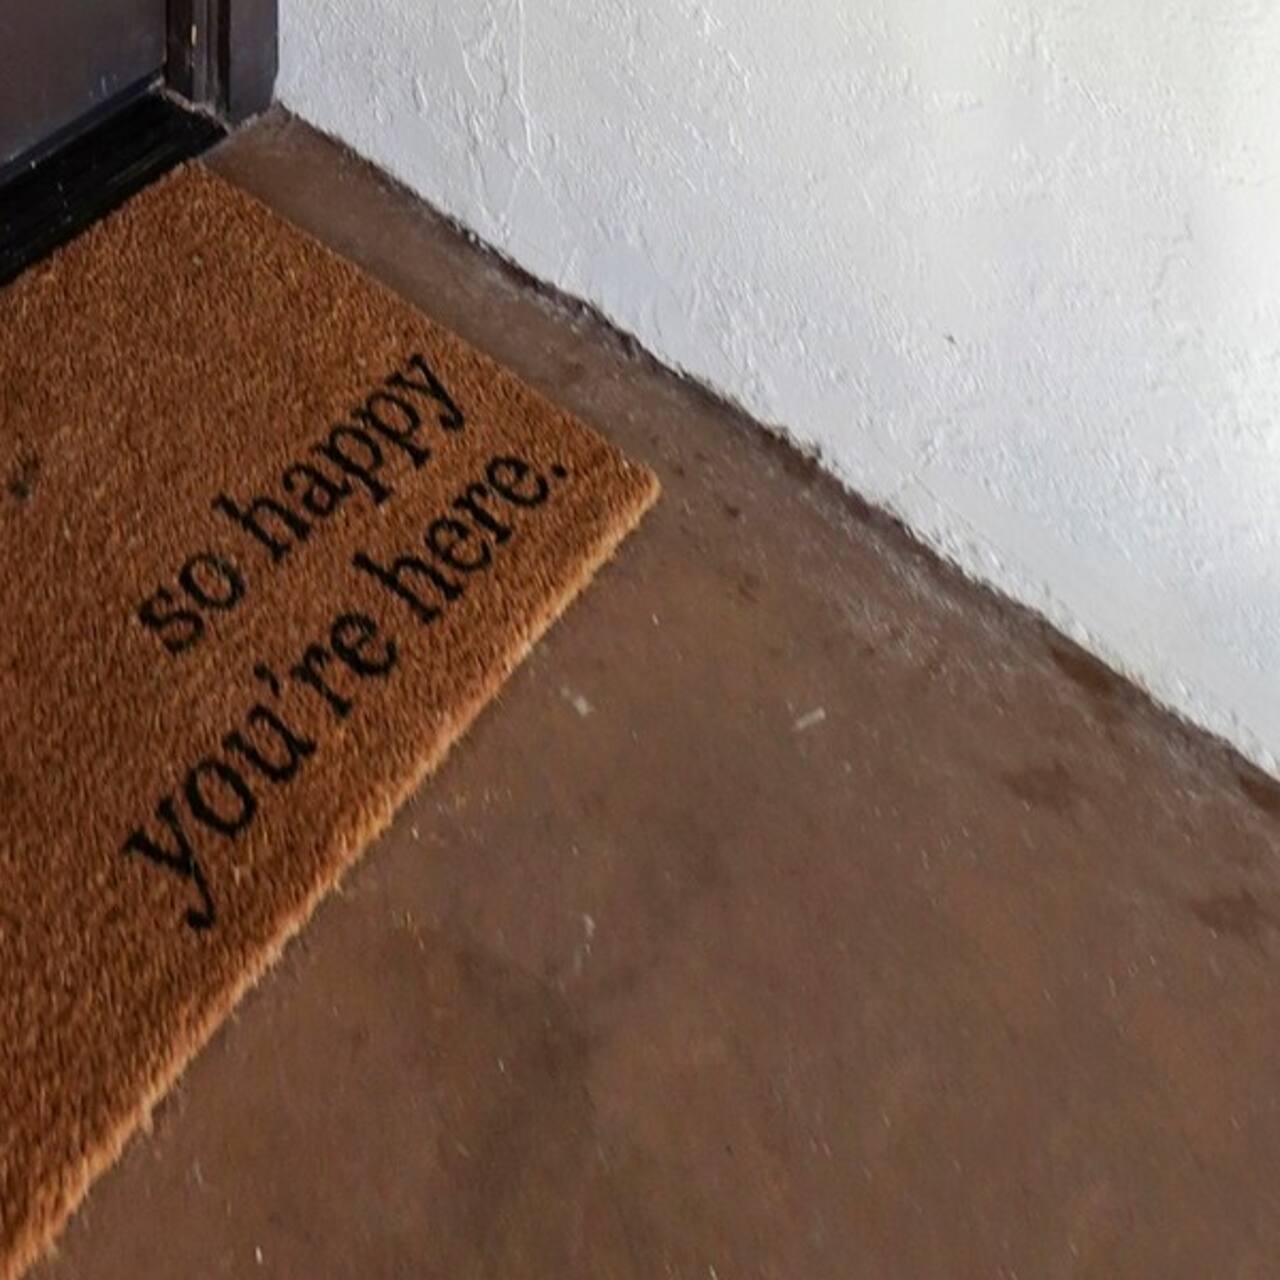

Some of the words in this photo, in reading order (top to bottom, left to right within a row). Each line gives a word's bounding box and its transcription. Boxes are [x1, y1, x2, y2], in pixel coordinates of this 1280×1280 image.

[123, 611, 398, 931] you're
[352, 455, 568, 625] here.
[138, 551, 245, 655] so
[211, 354, 464, 564] happy
